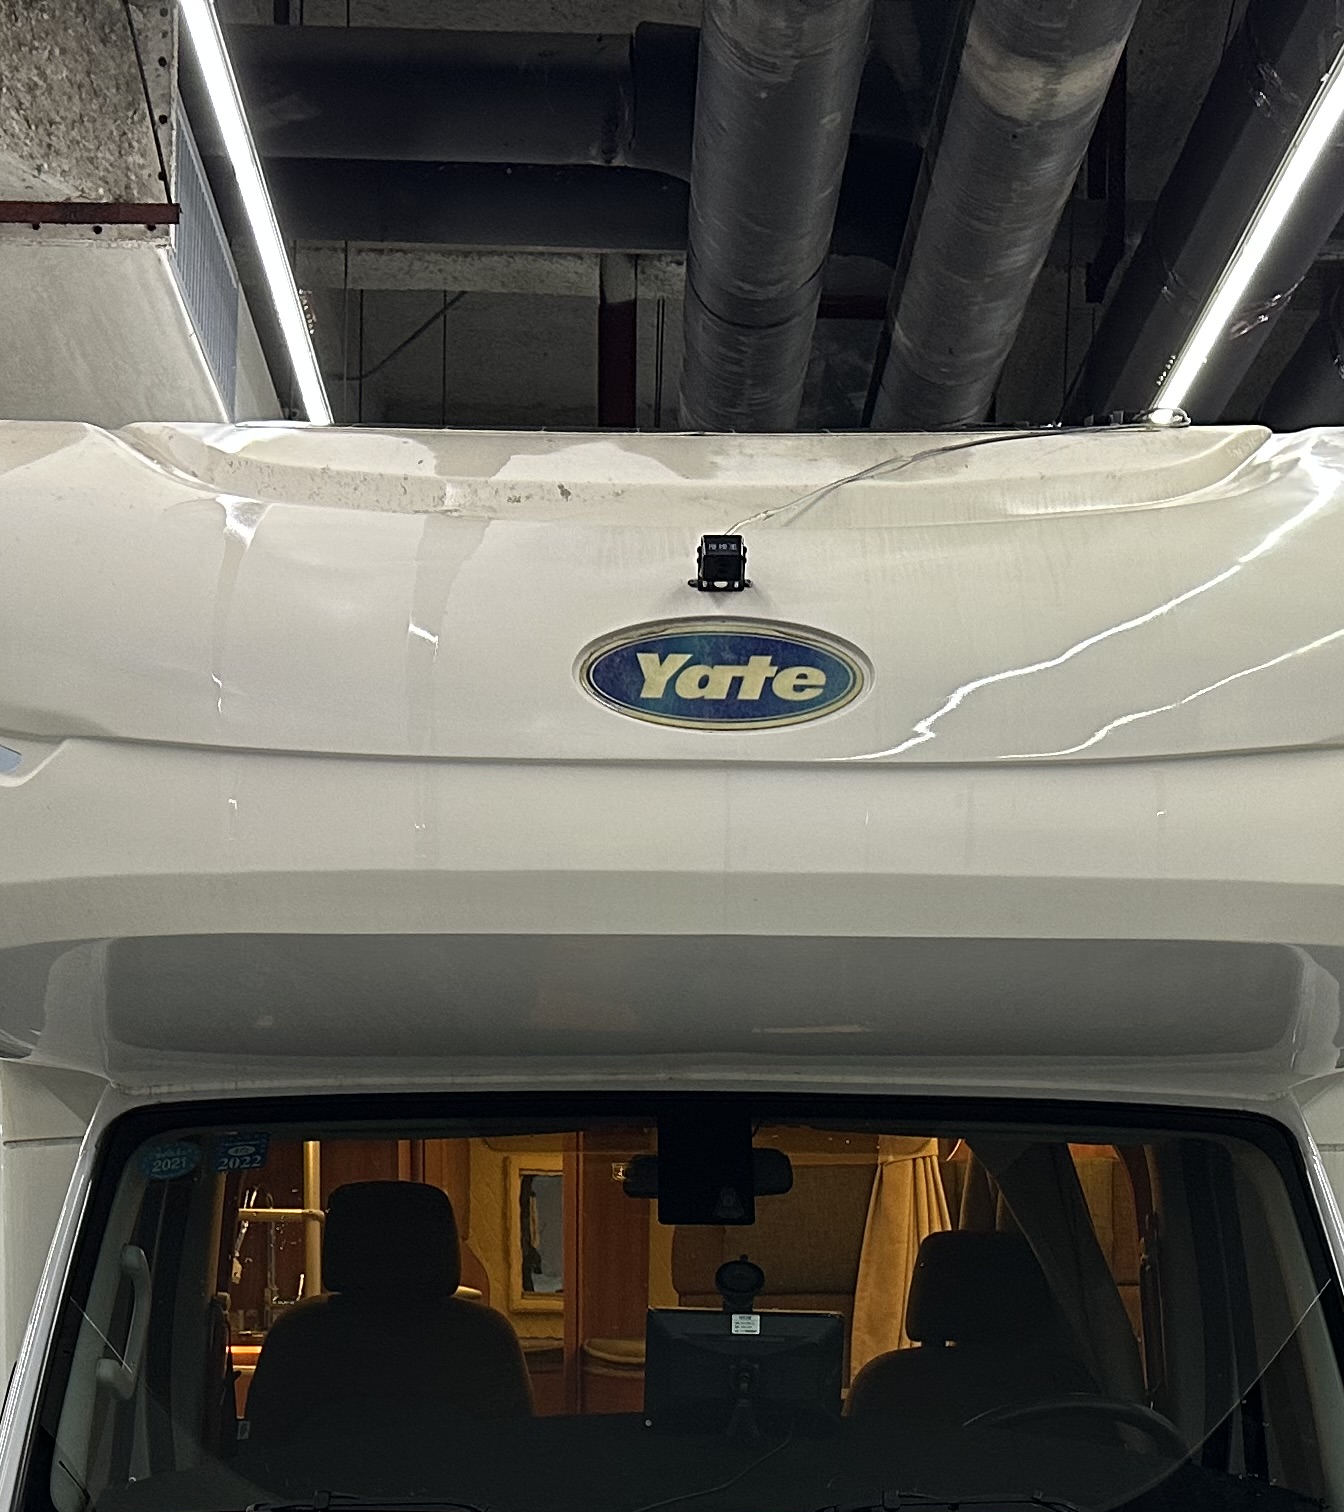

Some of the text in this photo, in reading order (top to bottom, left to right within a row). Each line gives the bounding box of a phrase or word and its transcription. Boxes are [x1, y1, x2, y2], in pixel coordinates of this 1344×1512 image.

[636, 652, 827, 702] Yate
[152, 1157, 186, 1172] 2021
[217, 1155, 261, 1171] 2022
